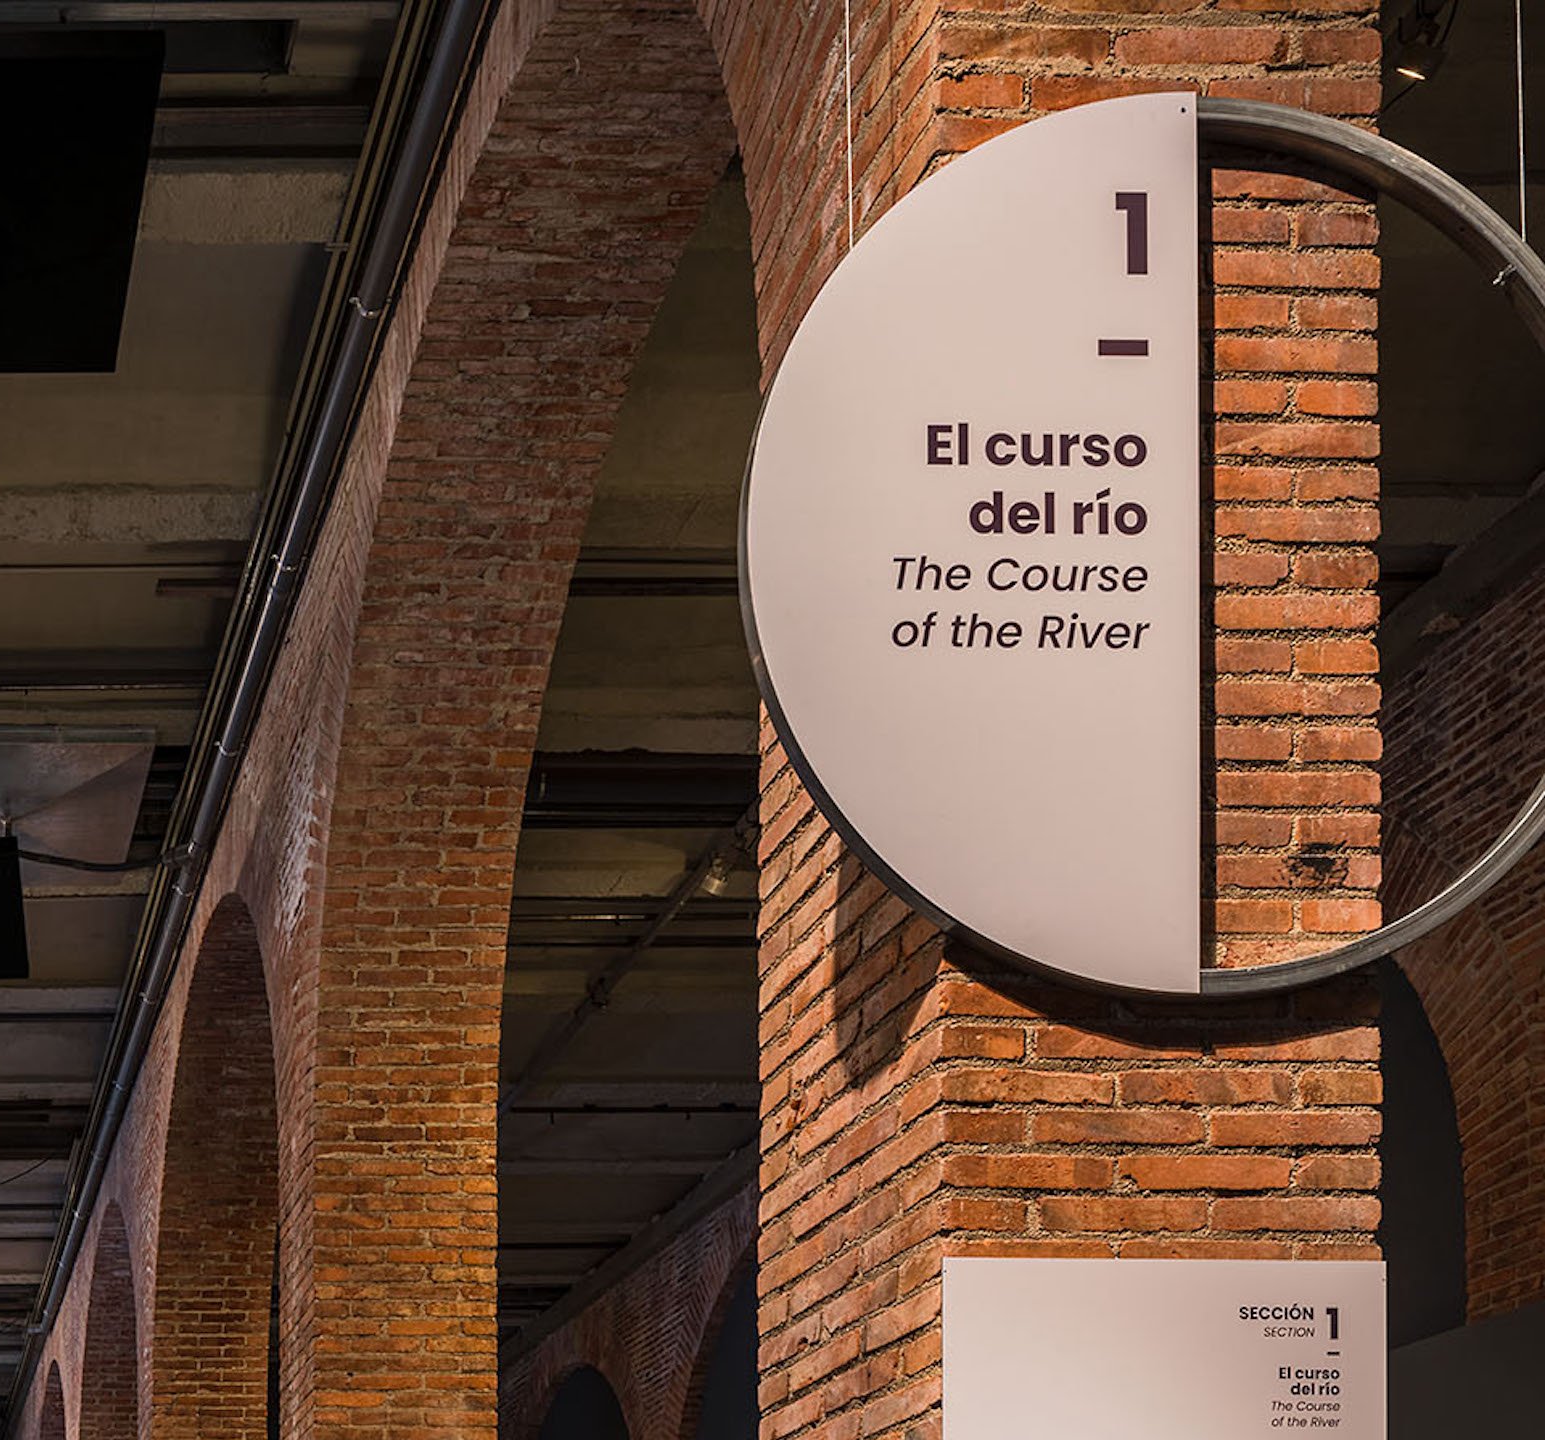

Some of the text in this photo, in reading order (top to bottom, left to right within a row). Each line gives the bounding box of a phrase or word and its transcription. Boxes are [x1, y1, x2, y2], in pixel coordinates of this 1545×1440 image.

[1116, 192, 1148, 275] 1
[928, 423, 1147, 467] El curso
[970, 488, 1147, 535] del río
[892, 556, 1147, 592] The Course
[891, 612, 1150, 649] of the River
[1239, 1303, 1314, 1320] SECCIÓN
[1326, 1307, 1338, 1340] 1
[1264, 1327, 1315, 1337] SECTION
[1279, 1367, 1339, 1379] El curso
[1291, 1382, 1340, 1395] del río
[1272, 1401, 1341, 1411] The Course
[1272, 1416, 1341, 1427] of the River
